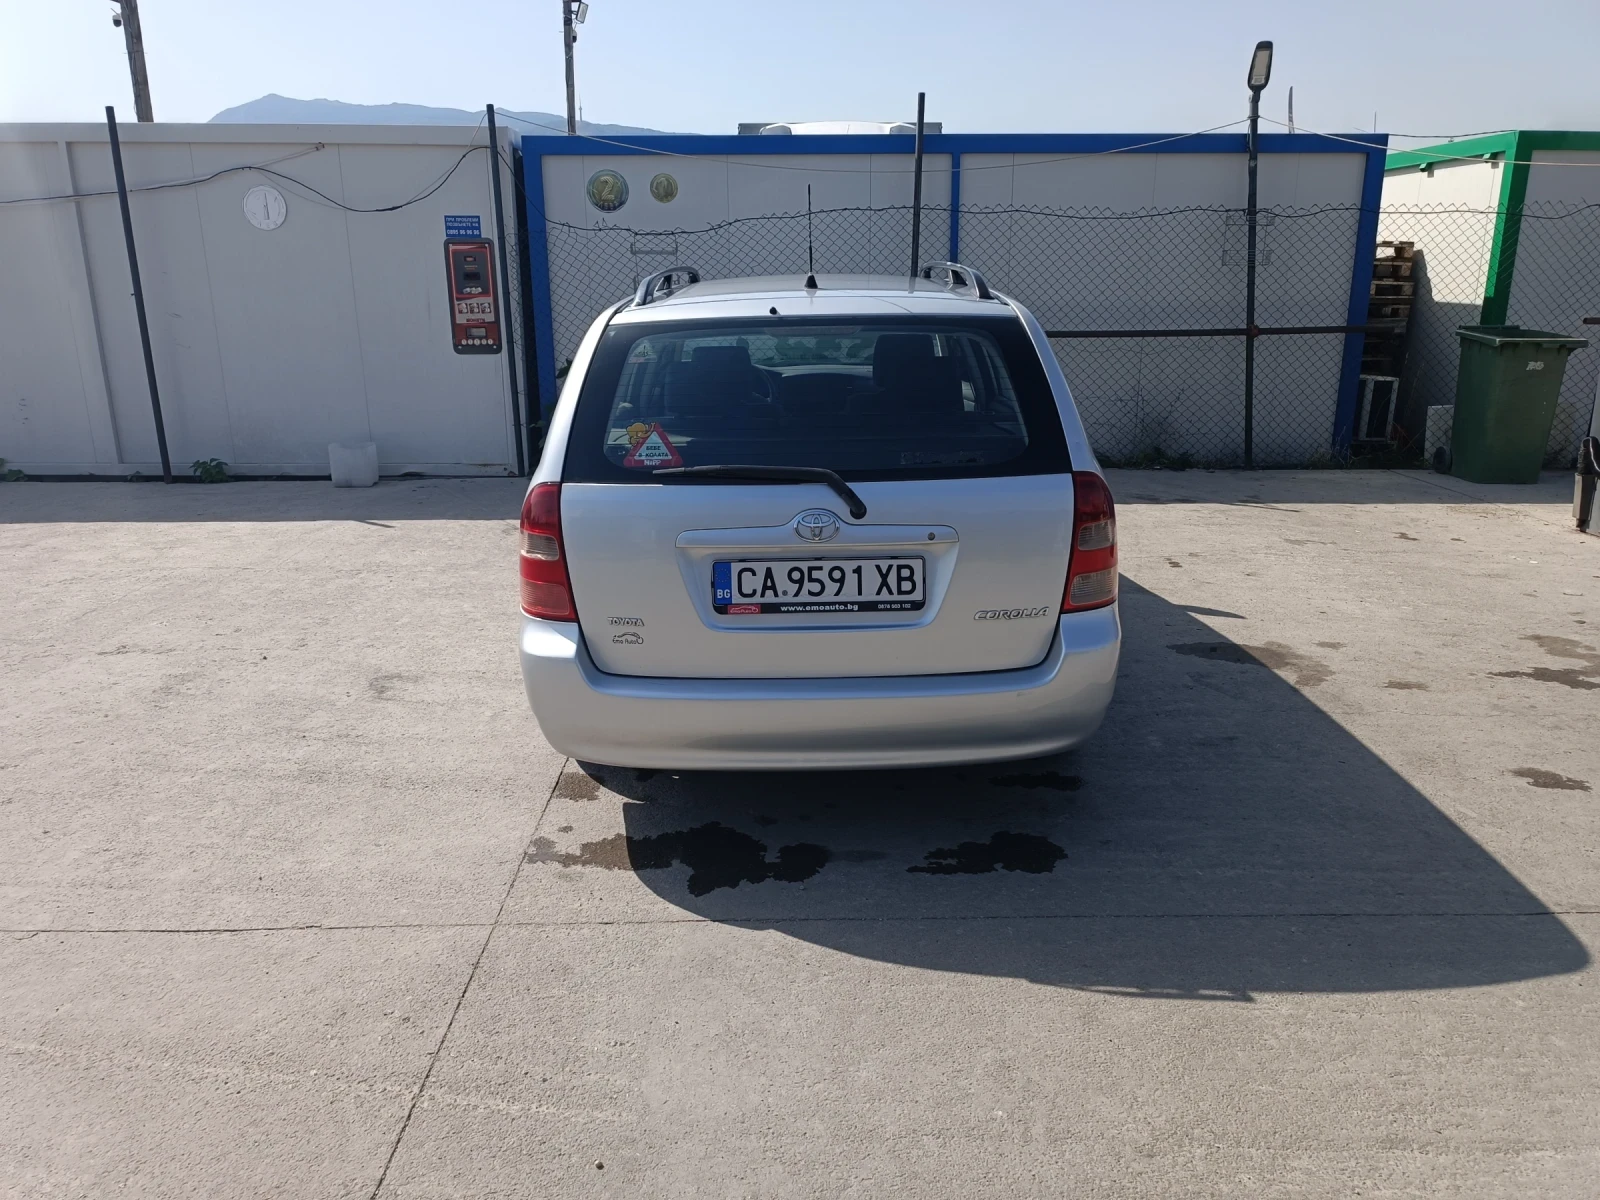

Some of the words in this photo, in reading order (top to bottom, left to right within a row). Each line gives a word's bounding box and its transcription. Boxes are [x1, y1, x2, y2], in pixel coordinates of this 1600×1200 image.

[737, 566, 779, 599] CA
[786, 564, 863, 598] 9591
[874, 563, 917, 597] XB
[716, 589, 731, 599] BG
[780, 603, 859, 612] www.emoauto.bg
[973, 606, 1050, 621] COROLLA
[607, 616, 645, 627] TOYOTA
